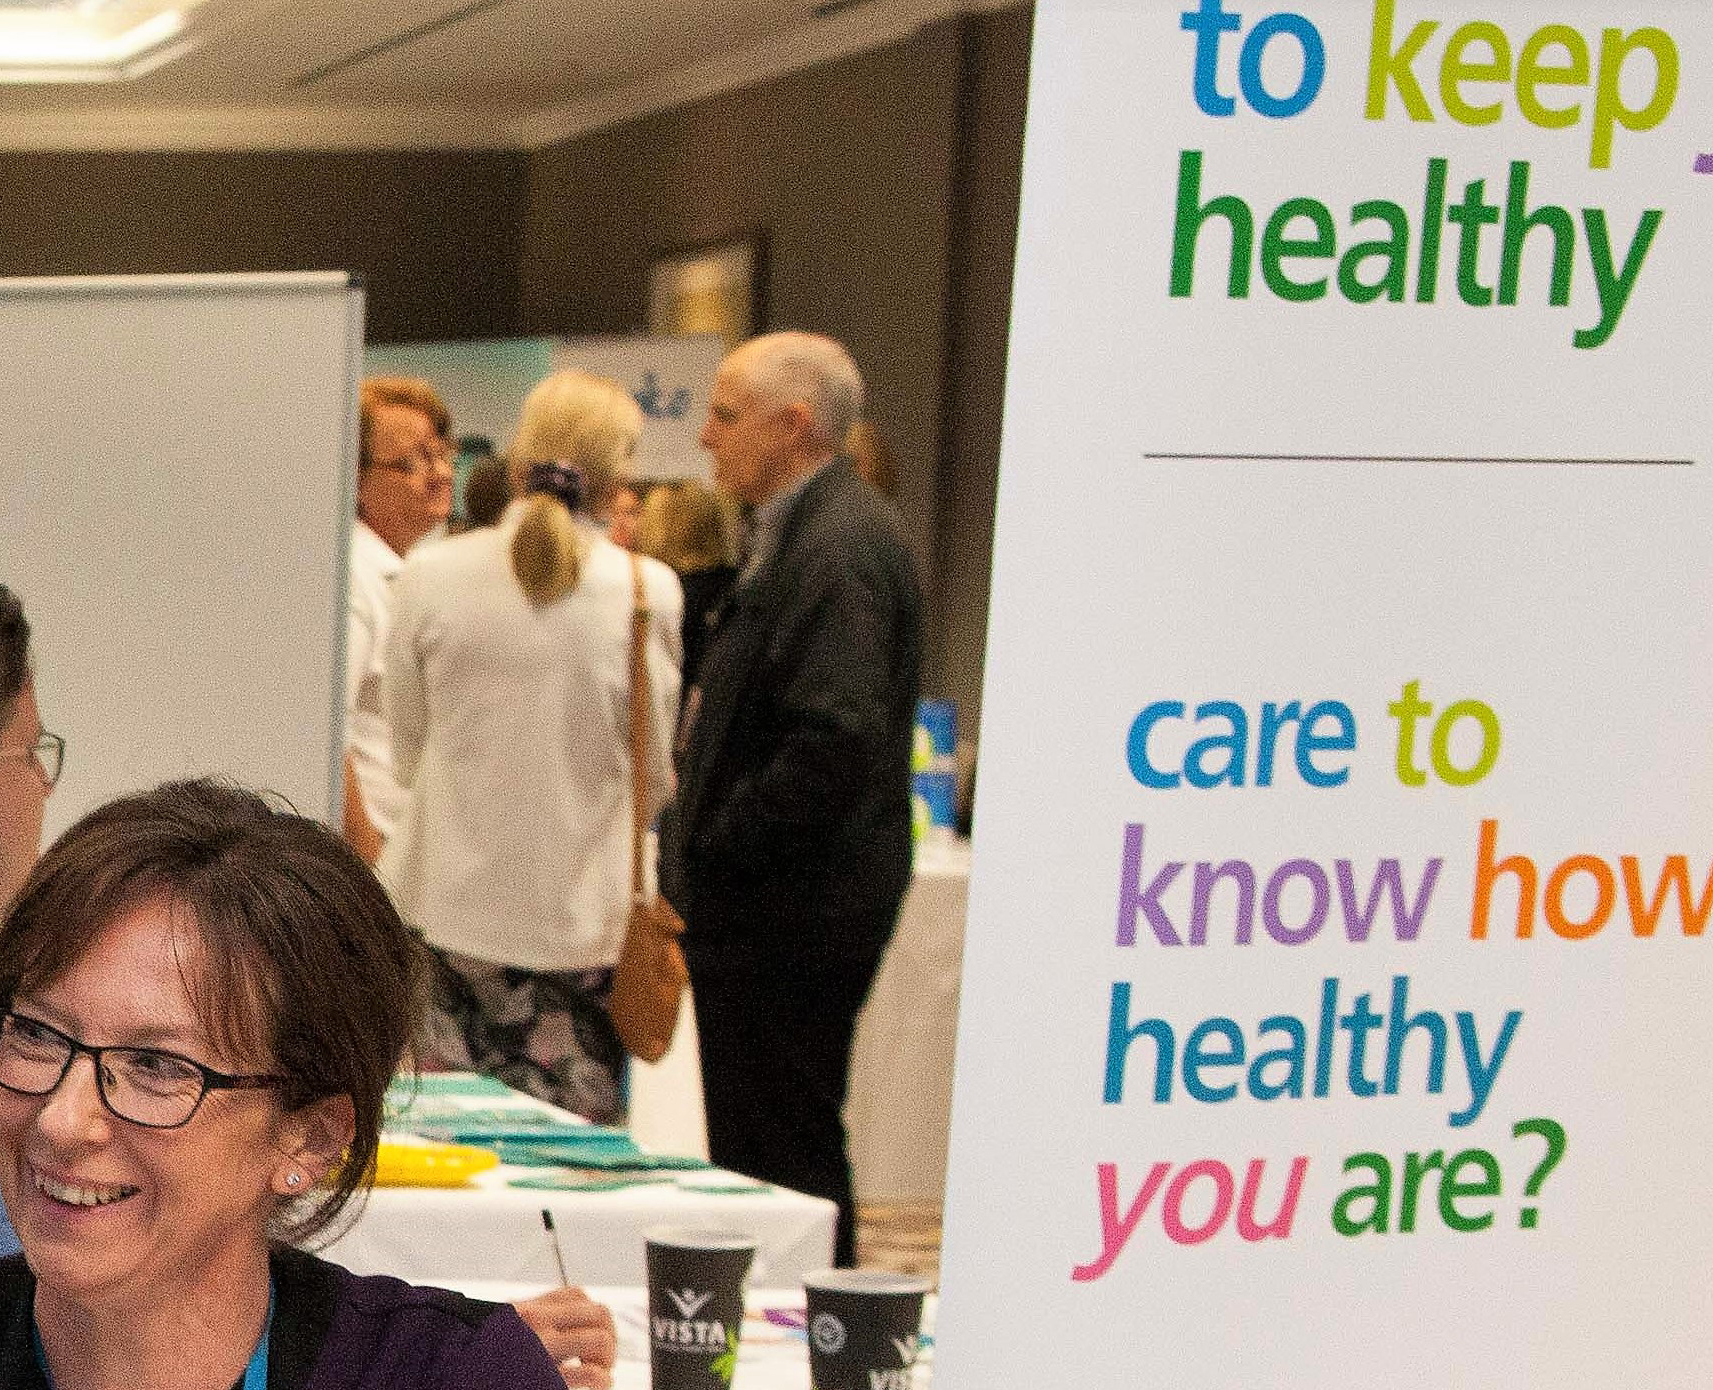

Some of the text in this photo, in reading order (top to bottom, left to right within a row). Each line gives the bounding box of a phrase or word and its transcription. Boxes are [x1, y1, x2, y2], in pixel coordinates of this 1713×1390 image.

[1180, 0, 1681, 169] to keep
[1168, 149, 1664, 350] healthy
[1125, 679, 1502, 789] care to
[1115, 819, 1713, 948] know how
[1102, 975, 1525, 1128] healthy
[1071, 1118, 1568, 1283] you are?
[652, 1319, 727, 1346] VISTA
